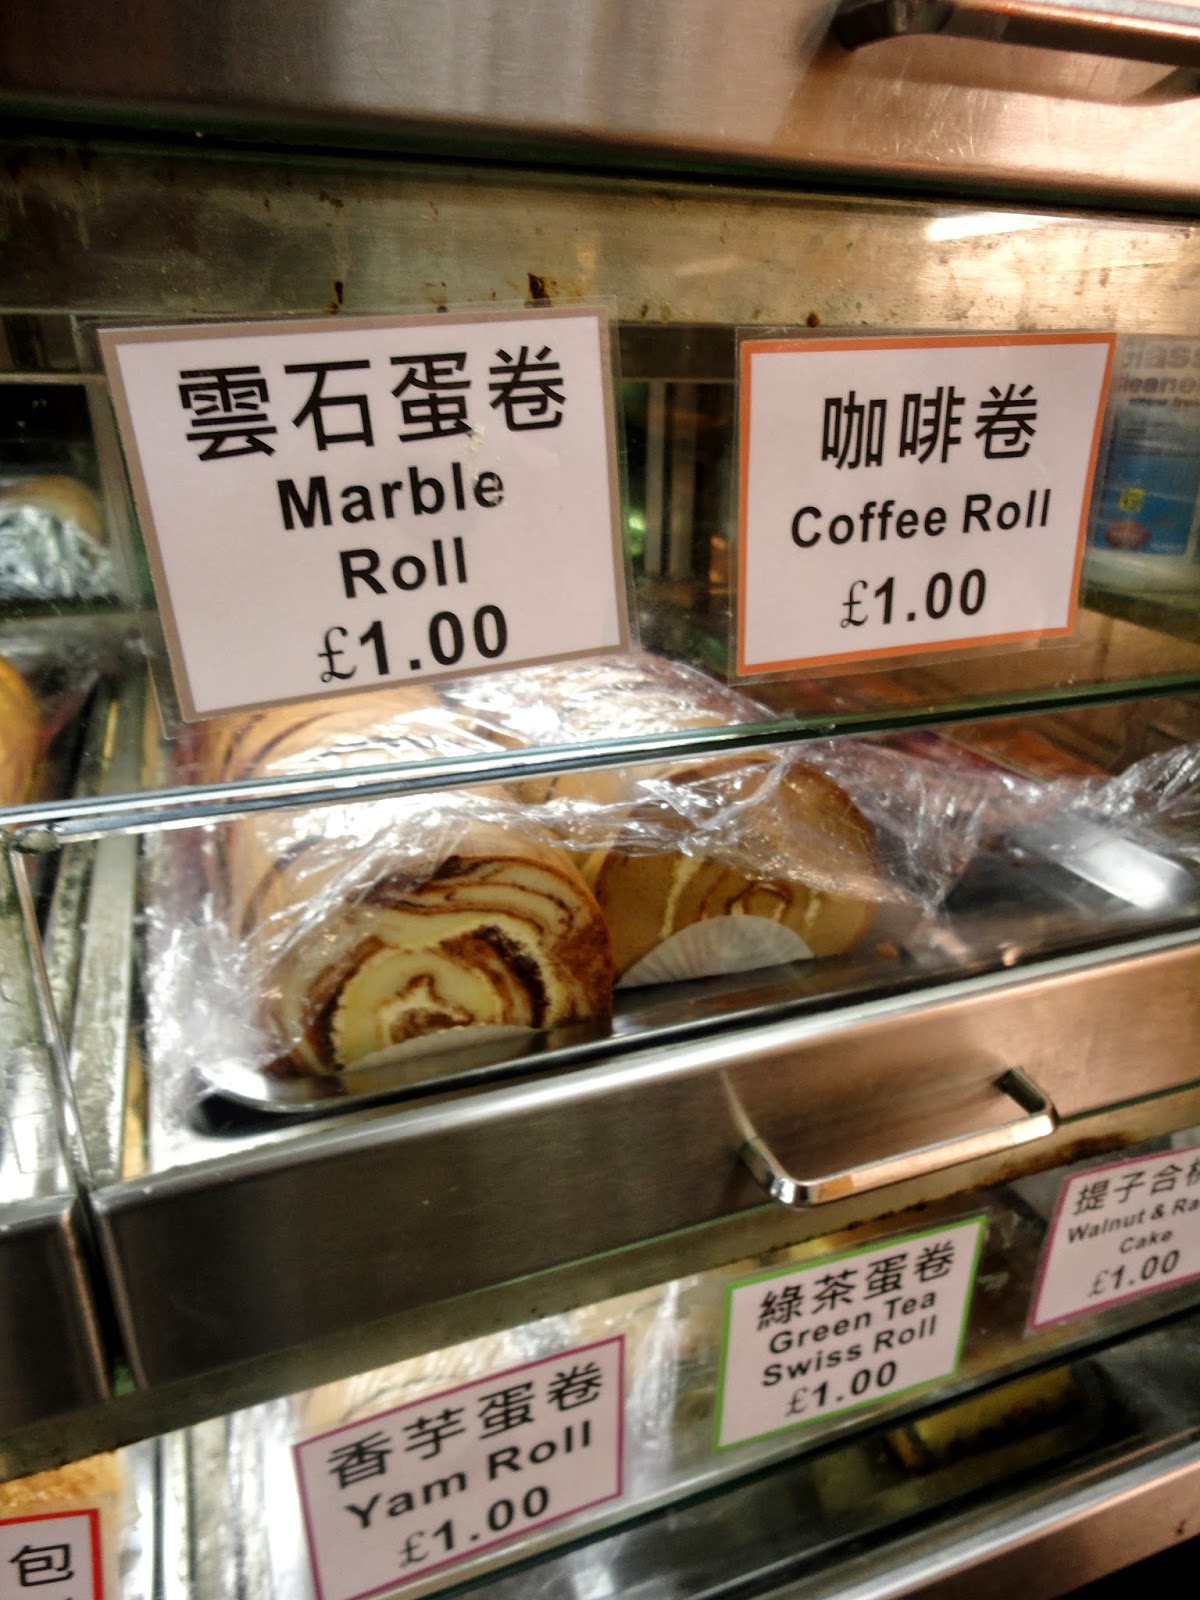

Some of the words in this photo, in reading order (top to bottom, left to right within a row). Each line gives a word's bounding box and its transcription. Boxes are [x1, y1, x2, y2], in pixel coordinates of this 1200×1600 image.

[179, 345, 567, 461] 雲石蛋卷
[821, 384, 1037, 470] 咖啡卷
[277, 462, 505, 530] Marble
[791, 500, 946, 548] Coffee
[963, 489, 1051, 533] Roll
[340, 537, 468, 598] Roll
[840, 569, 986, 628] £1.00
[318, 605, 508, 682] £1.00
[1067, 1209, 1145, 1243] Walnut
[1151, 1203, 1165, 1220] &
[1120, 1230, 1173, 1254] Cake
[757, 1240, 954, 1331] 綠茶蛋卷
[1088, 1250, 1180, 1297] £1.00
[762, 1344, 862, 1387] Swiss
[874, 1315, 936, 1353] Roll
[769, 1311, 871, 1354] Green
[884, 1292, 936, 1319] Tea
[785, 1361, 896, 1416] £1.00
[327, 1362, 601, 1489] 香芋蛋卷
[345, 1471, 466, 1529] Yam
[488, 1420, 591, 1480] Roll
[399, 1486, 548, 1568] £1.00
[10, 1543, 74, 1587] 包
